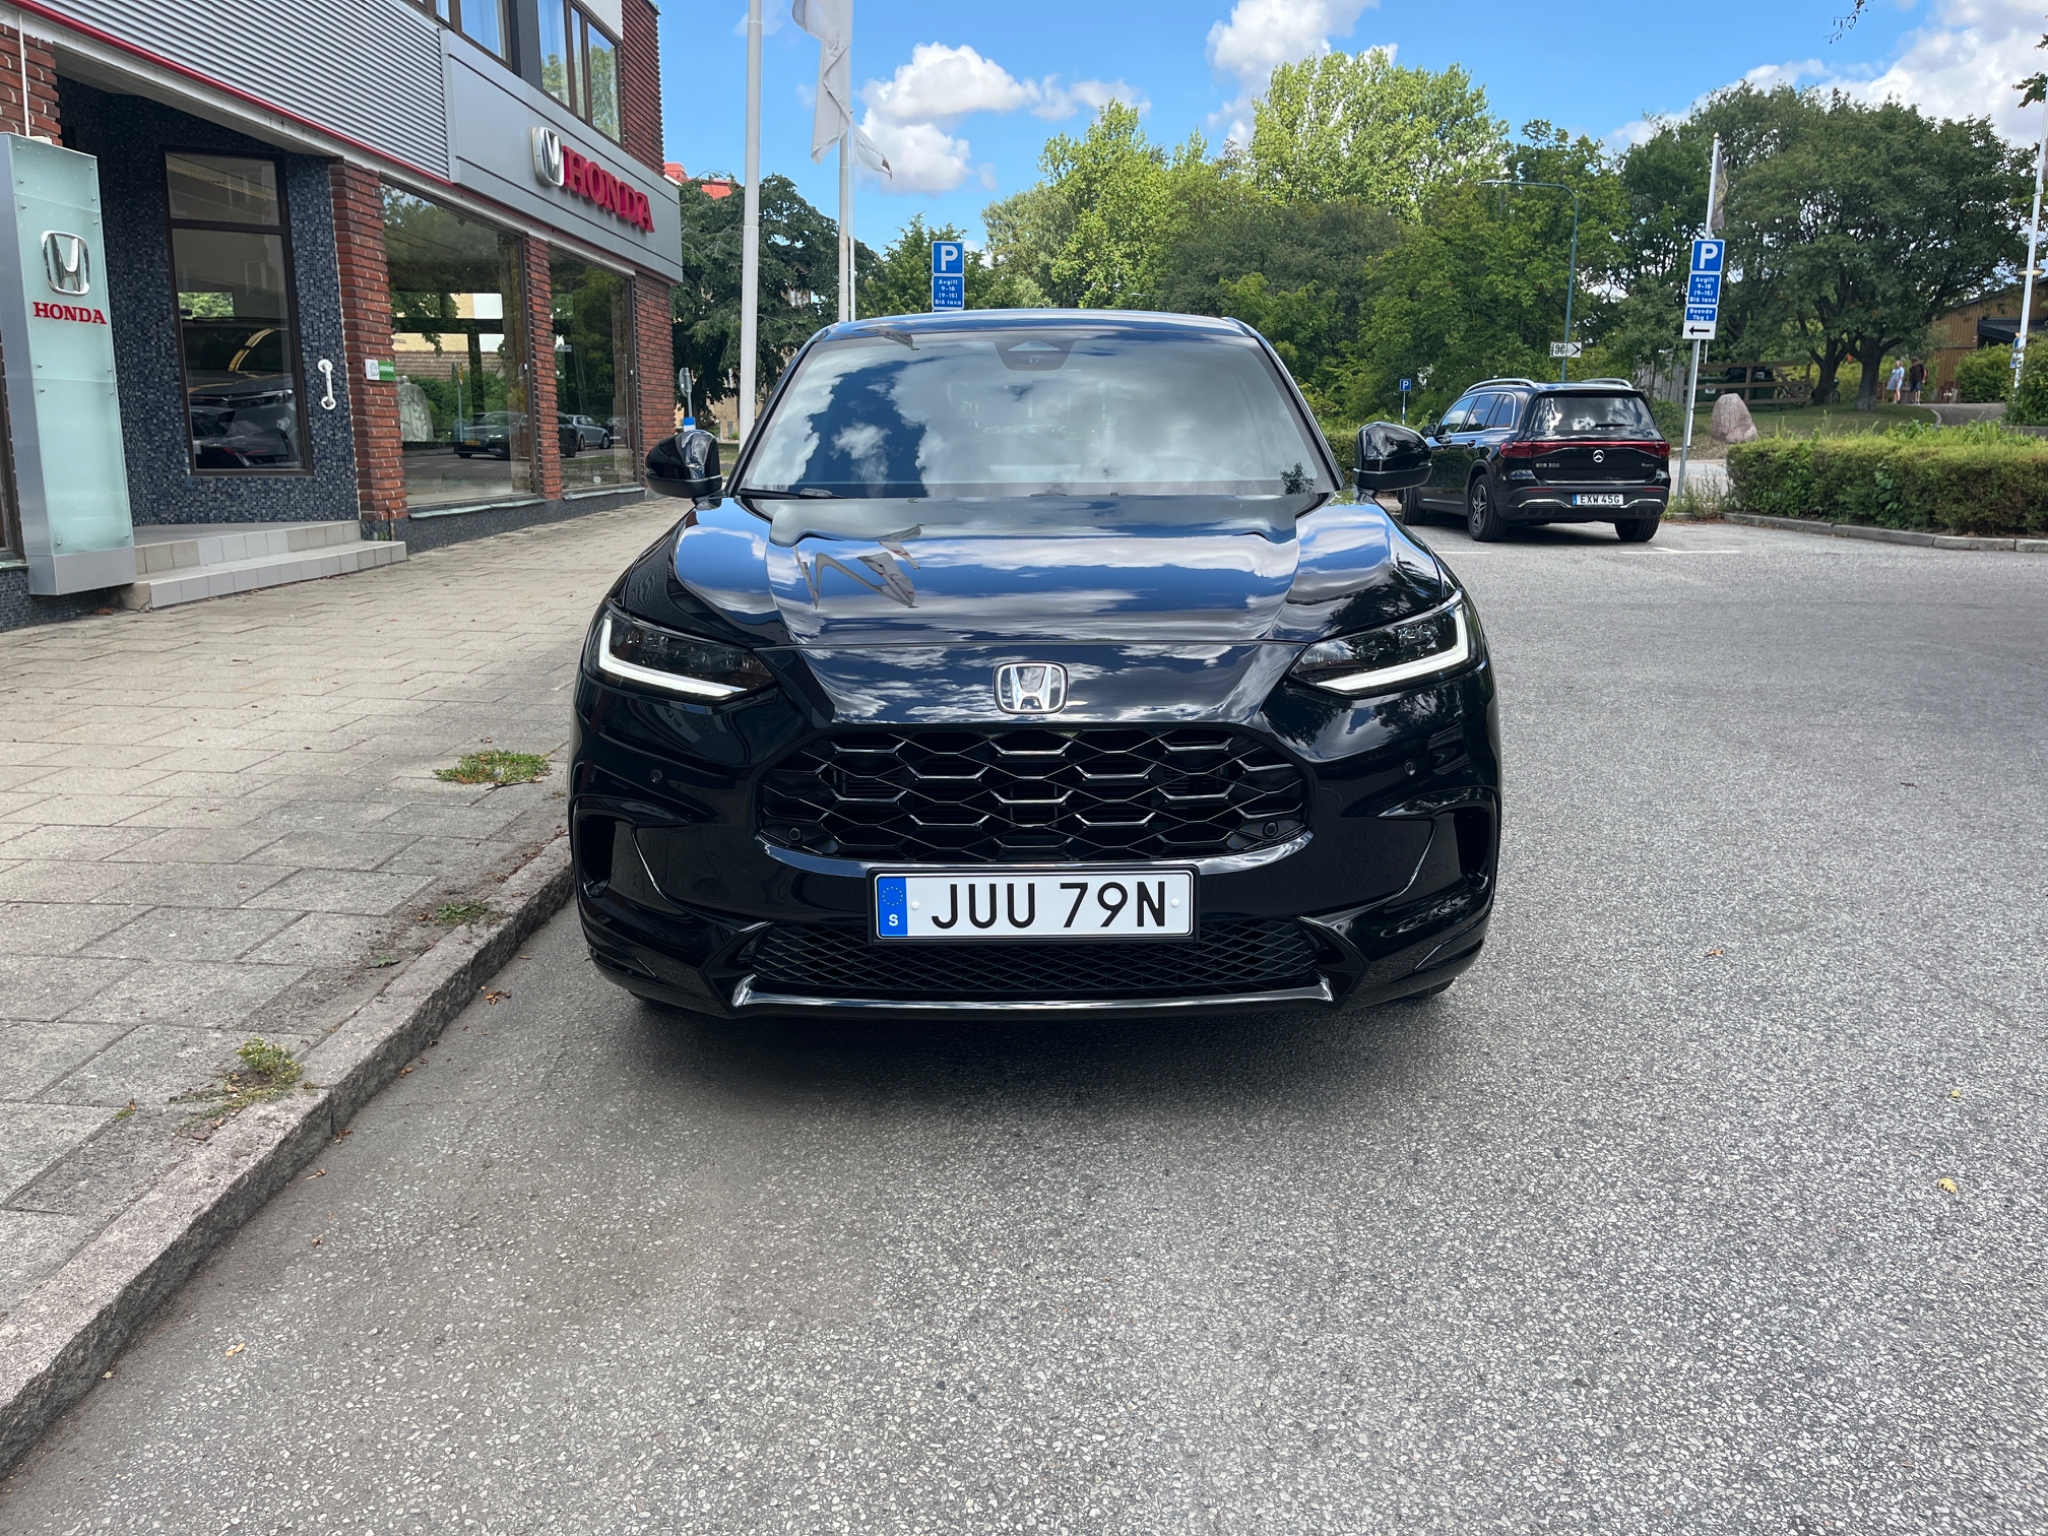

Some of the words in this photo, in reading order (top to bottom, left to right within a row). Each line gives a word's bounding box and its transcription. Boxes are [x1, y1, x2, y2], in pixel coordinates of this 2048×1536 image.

[562, 145, 655, 233] HONDA
[941, 245, 959, 271] P
[1699, 243, 1719, 269] P
[32, 301, 108, 325] HONDA
[1580, 494, 1599, 504] EXW
[1601, 494, 1620, 504] 45G
[888, 914, 899, 926] S
[931, 882, 1036, 929] JUU
[1060, 880, 1166, 928] 79N
